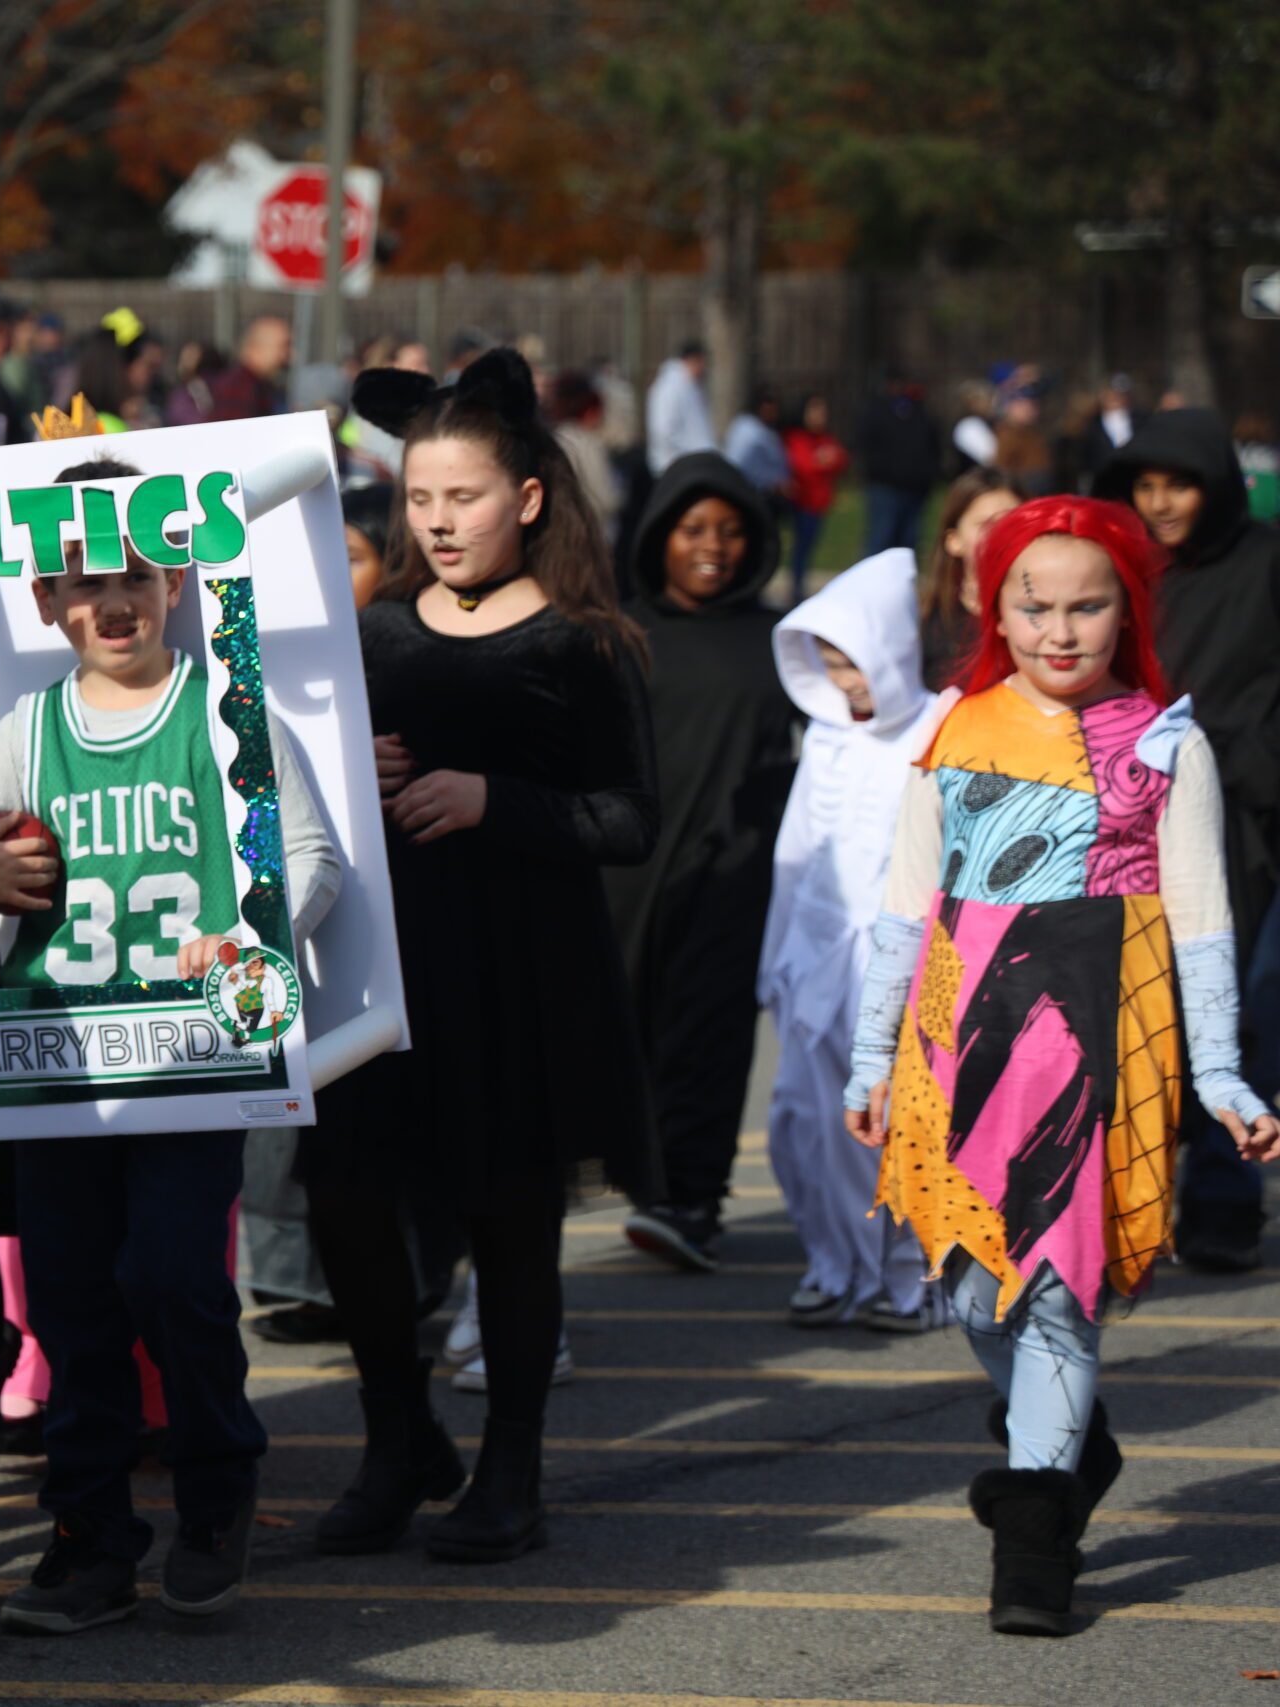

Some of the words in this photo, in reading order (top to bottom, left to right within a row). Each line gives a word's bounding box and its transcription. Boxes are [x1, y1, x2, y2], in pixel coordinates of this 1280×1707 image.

[50, 781, 198, 860] CELTICS
[44, 872, 202, 985] 33
[207, 965, 227, 1022] BOSTON
[275, 961, 299, 1022] CELTICS
